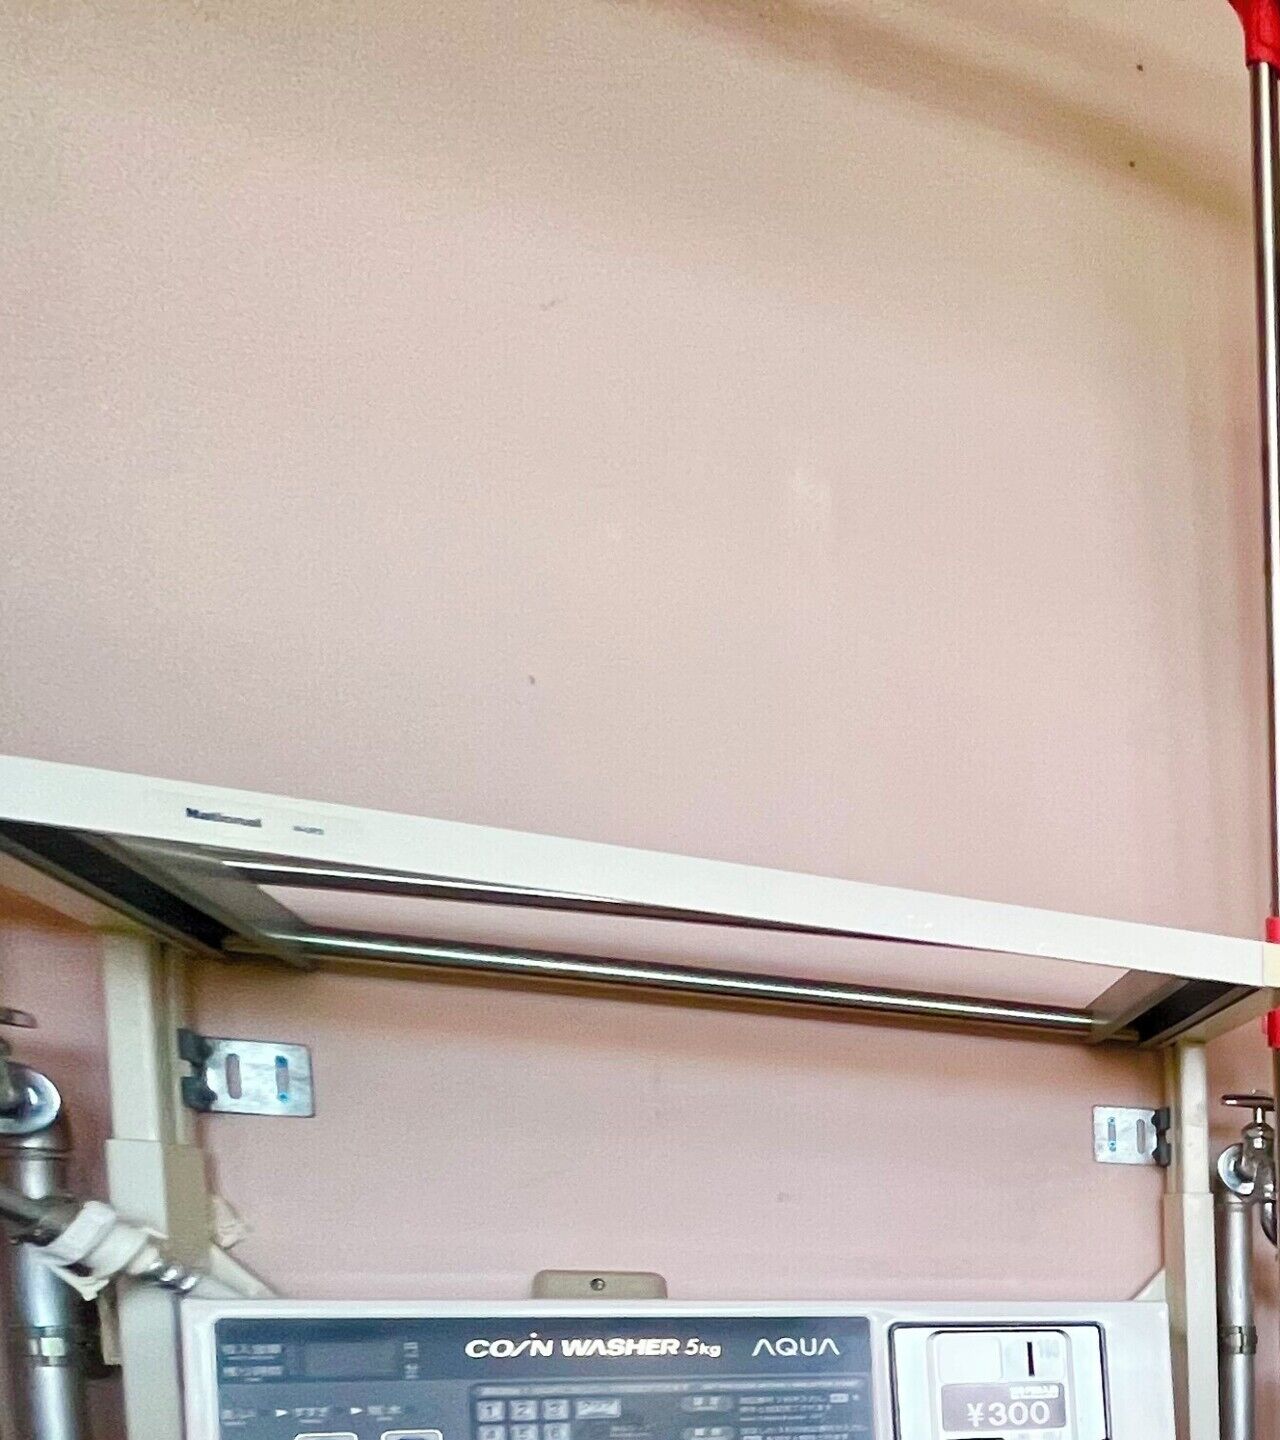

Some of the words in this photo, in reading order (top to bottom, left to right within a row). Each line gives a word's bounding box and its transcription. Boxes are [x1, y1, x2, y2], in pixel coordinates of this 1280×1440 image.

[560, 1338, 680, 1358] WASHER
[684, 1338, 722, 1359] 5kg
[752, 1338, 841, 1357] AQUA
[967, 1400, 1051, 1427] ¥300
